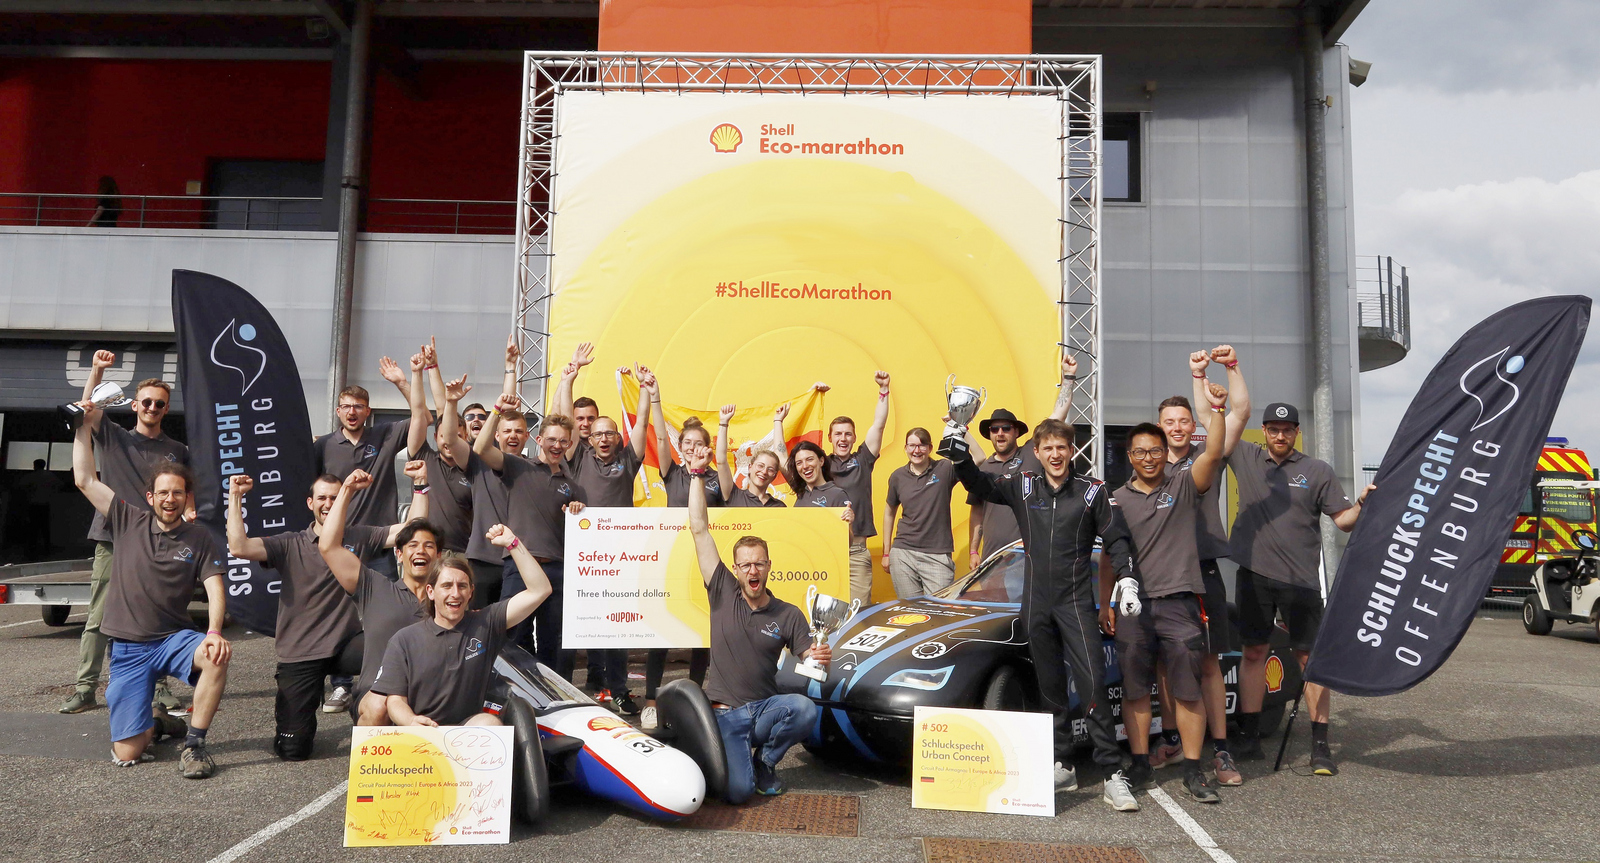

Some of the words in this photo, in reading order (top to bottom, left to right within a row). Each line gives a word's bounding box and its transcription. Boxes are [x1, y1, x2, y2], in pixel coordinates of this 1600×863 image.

[760, 124, 795, 136] Shell
[759, 138, 904, 155] Eco-marathon
[715, 281, 892, 300] #ShellEcoMarathon
[251, 397, 285, 594] OENBURG
[659, 523, 687, 532] Europe
[707, 523, 730, 531] Africa
[731, 523, 752, 531] 2023
[1357, 429, 1460, 648] SCHLUCKSPECHT
[578, 551, 616, 565] Safety
[619, 551, 659, 562] Award
[1395, 439, 1501, 667] OFFENBURG
[578, 566, 621, 576] Winner
[769, 571, 828, 583] $3,000.00
[577, 590, 600, 598] Three
[602, 589, 640, 598] thousand
[642, 589, 671, 598] dollars
[609, 612, 640, 623] DUPONT
[850, 634, 887, 647] 502
[930, 724, 948, 733] 502
[451, 731, 491, 747] 622
[922, 739, 984, 752] Schluckspecht
[371, 745, 393, 756] 306
[922, 750, 950, 760] Urban
[952, 752, 990, 764] Concept
[359, 763, 433, 777] Schluckspecht
[387, 782, 414, 791] Armagnac
[419, 782, 437, 790] Europe
